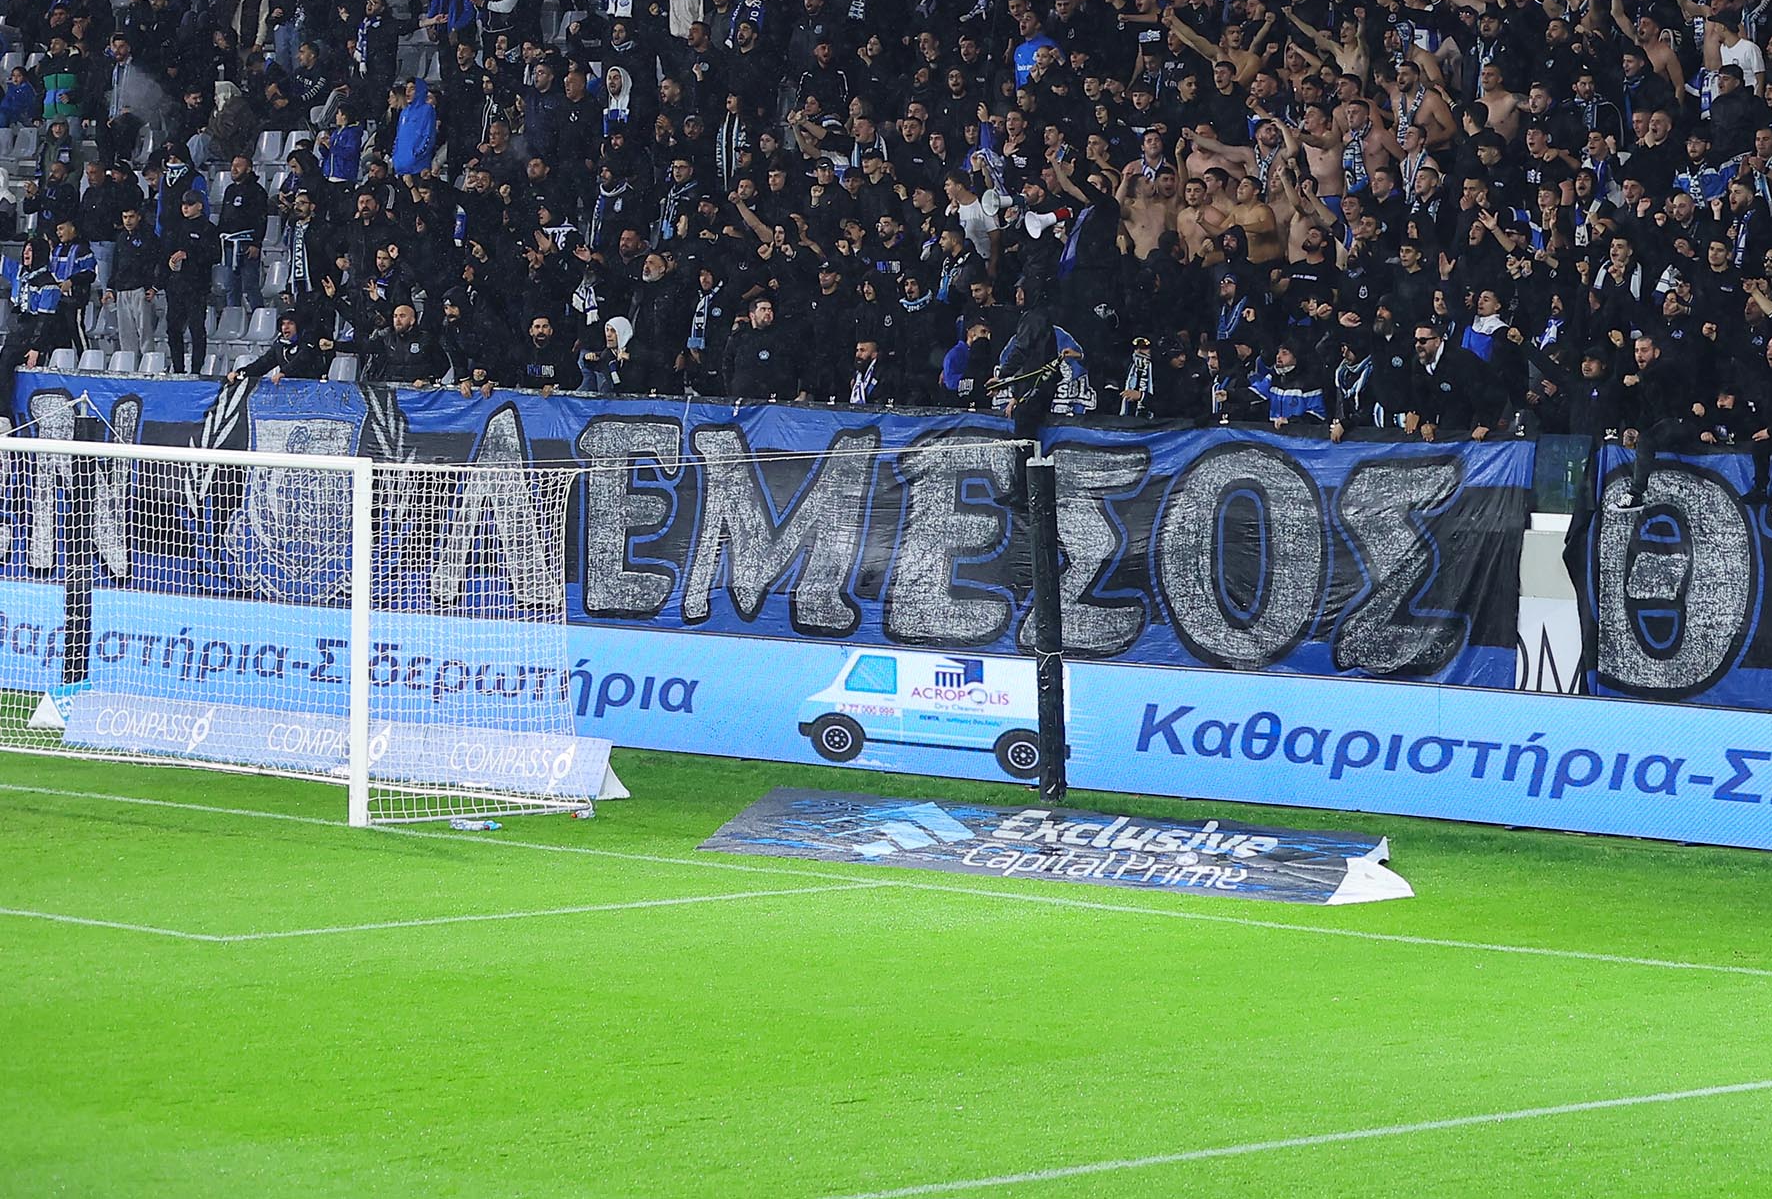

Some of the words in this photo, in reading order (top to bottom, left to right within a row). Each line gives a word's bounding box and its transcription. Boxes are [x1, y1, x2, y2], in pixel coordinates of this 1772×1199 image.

[428, 400, 1468, 678] ΛΕΜΕΣΟΣ
[911, 687, 1010, 706] ACROPOLIS
[95, 708, 191, 743] COMPASS
[450, 742, 552, 779] COMPASS
[991, 809, 1278, 858] Exclusive
[960, 843, 1113, 878] Capital
[1113, 850, 1250, 890] Prime
